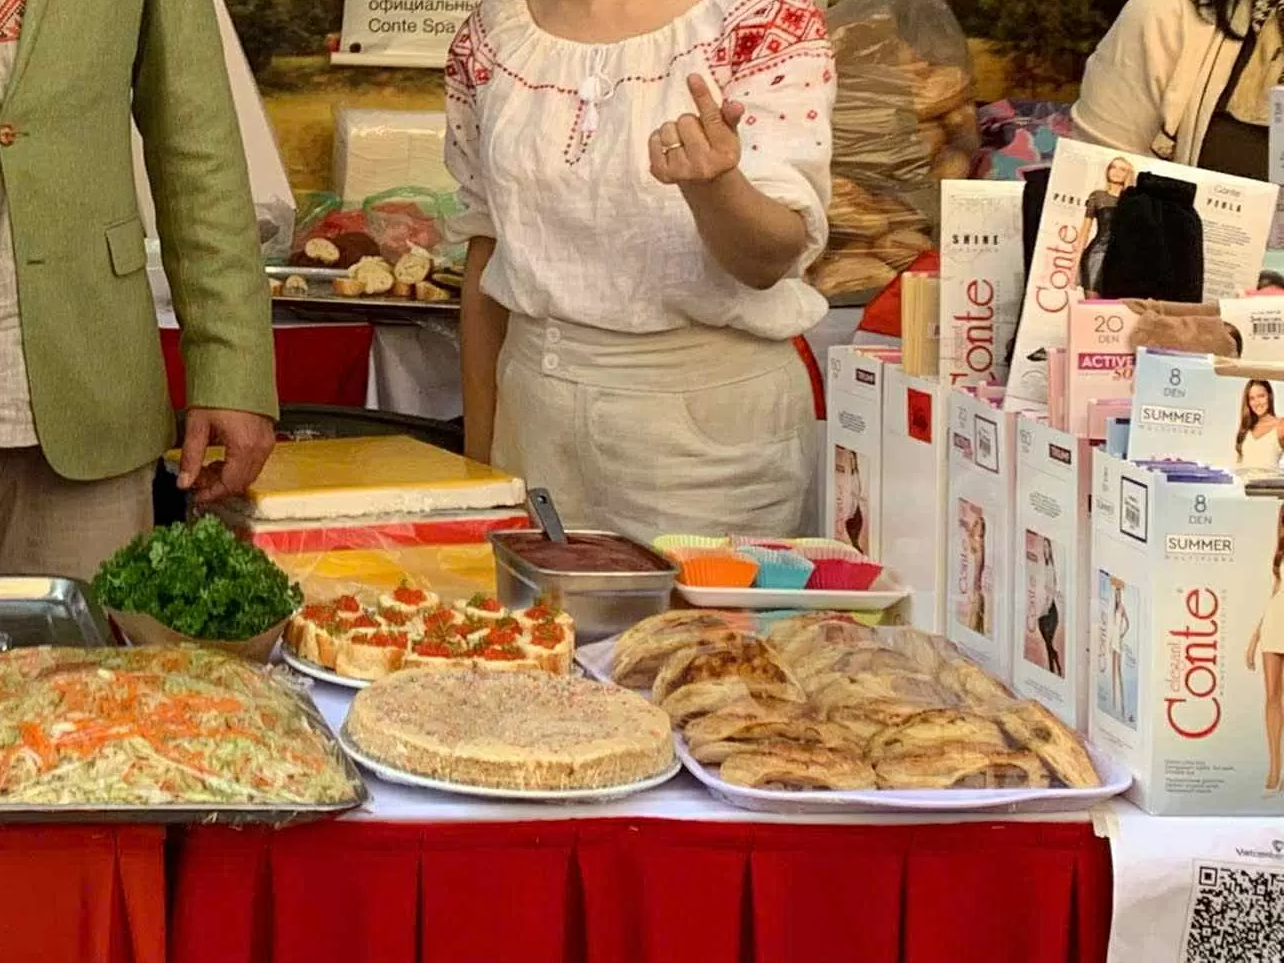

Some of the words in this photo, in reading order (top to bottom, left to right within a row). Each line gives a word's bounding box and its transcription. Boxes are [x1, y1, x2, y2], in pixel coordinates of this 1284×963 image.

[368, 18, 417, 33] Conte
[422, 18, 456, 36] Spa
[952, 234, 999, 246] SHINE
[1036, 224, 1079, 313] Conte
[1094, 315, 1124, 333] 20
[1098, 335, 1120, 344] DEN
[1082, 355, 1133, 368] ACTIVE
[1169, 367, 1181, 386] 8
[1163, 388, 1186, 398] DEN
[1143, 408, 1203, 425] SUMMER
[1193, 494, 1208, 513] 8
[1188, 515, 1213, 524] DEN
[1168, 537, 1233, 552] SUMMER
[1164, 587, 1222, 740] Conte
[1164, 640, 1185, 693] elegant
